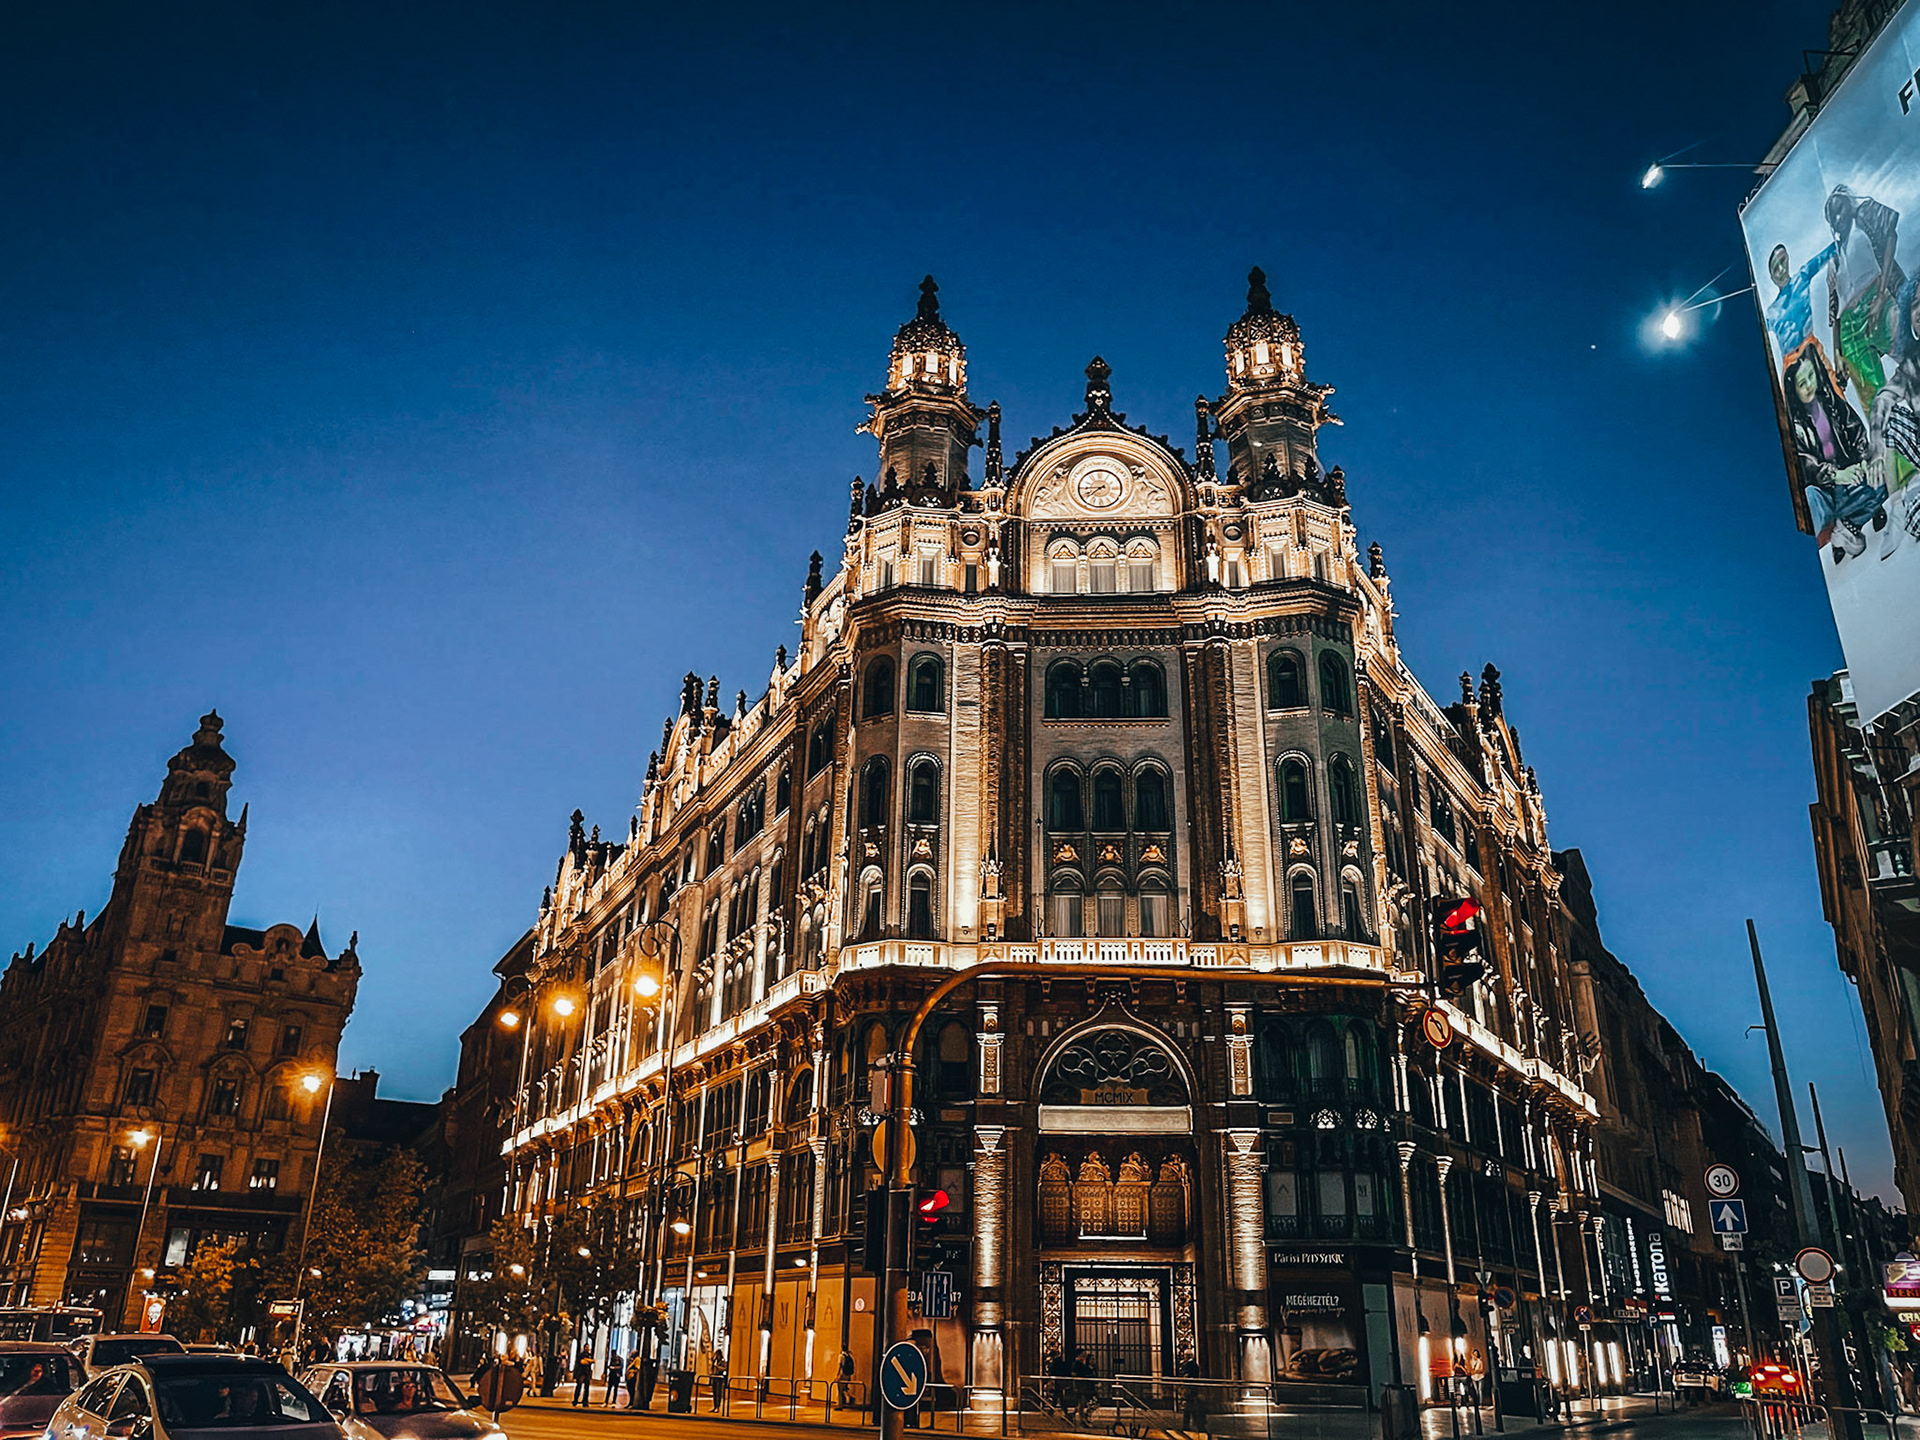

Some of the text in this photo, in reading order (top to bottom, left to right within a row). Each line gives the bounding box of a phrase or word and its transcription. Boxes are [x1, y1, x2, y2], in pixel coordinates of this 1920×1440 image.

[1095, 1092, 1134, 1104] MCMIX
[1713, 1174, 1731, 1188] 30
[1779, 1280, 1791, 1295] P
[1285, 1293, 1339, 1306] MEGÉHEZTÉL?
[1649, 1316, 1658, 1327] P
